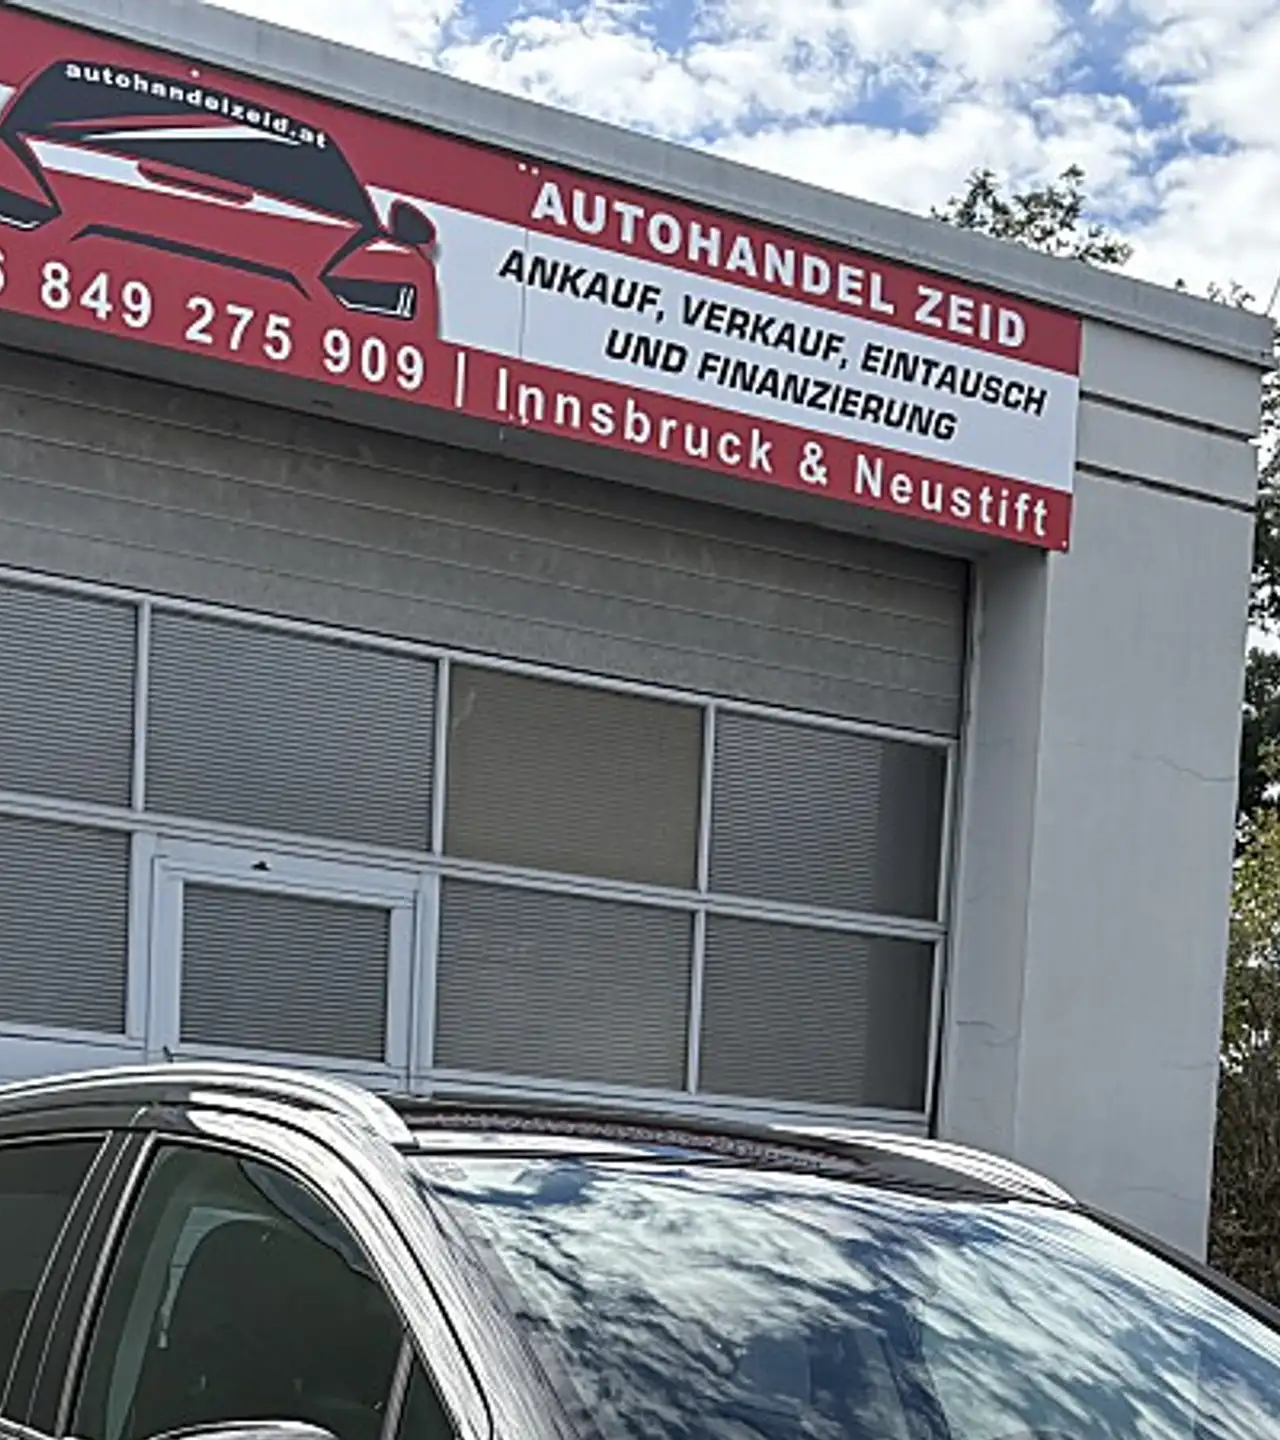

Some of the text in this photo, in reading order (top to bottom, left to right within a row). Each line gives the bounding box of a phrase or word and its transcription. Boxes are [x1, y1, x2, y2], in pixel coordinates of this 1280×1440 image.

[66, 62, 327, 149] autohandelzeid.at
[499, 248, 1047, 417] ANKAUF, VERKAUF, EINTAUSCH
[530, 180, 1027, 350] AUTOHANDEL ZEID
[41, 261, 153, 329] 849
[184, 296, 293, 362] 275
[322, 328, 423, 391] 909
[496, 366, 774, 474] Innsbruck
[799, 443, 829, 486] &
[854, 452, 1047, 537] Neustift
[605, 329, 958, 441] UND FINANZIERUNG
